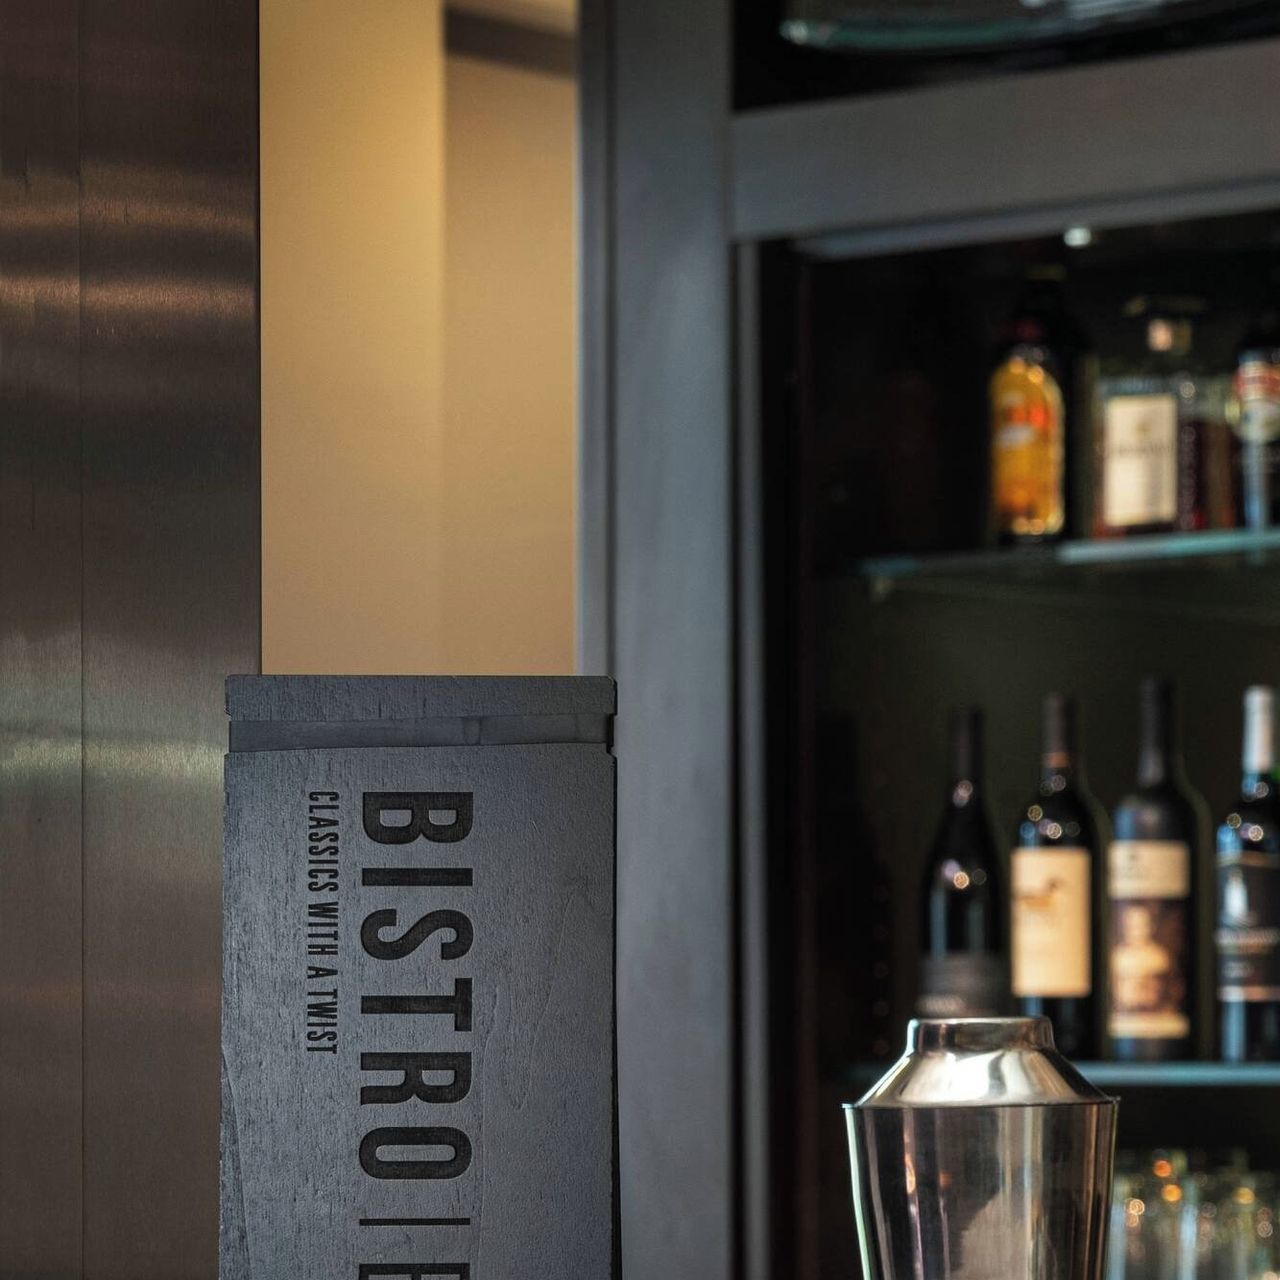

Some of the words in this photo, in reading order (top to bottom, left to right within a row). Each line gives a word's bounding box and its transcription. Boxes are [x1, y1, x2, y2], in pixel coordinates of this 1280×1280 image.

[308, 791, 340, 892] CLASSICS
[307, 901, 339, 956] WITH
[306, 966, 338, 979] A
[359, 791, 474, 1180] BISTRO
[306, 988, 338, 1055] TWIST
